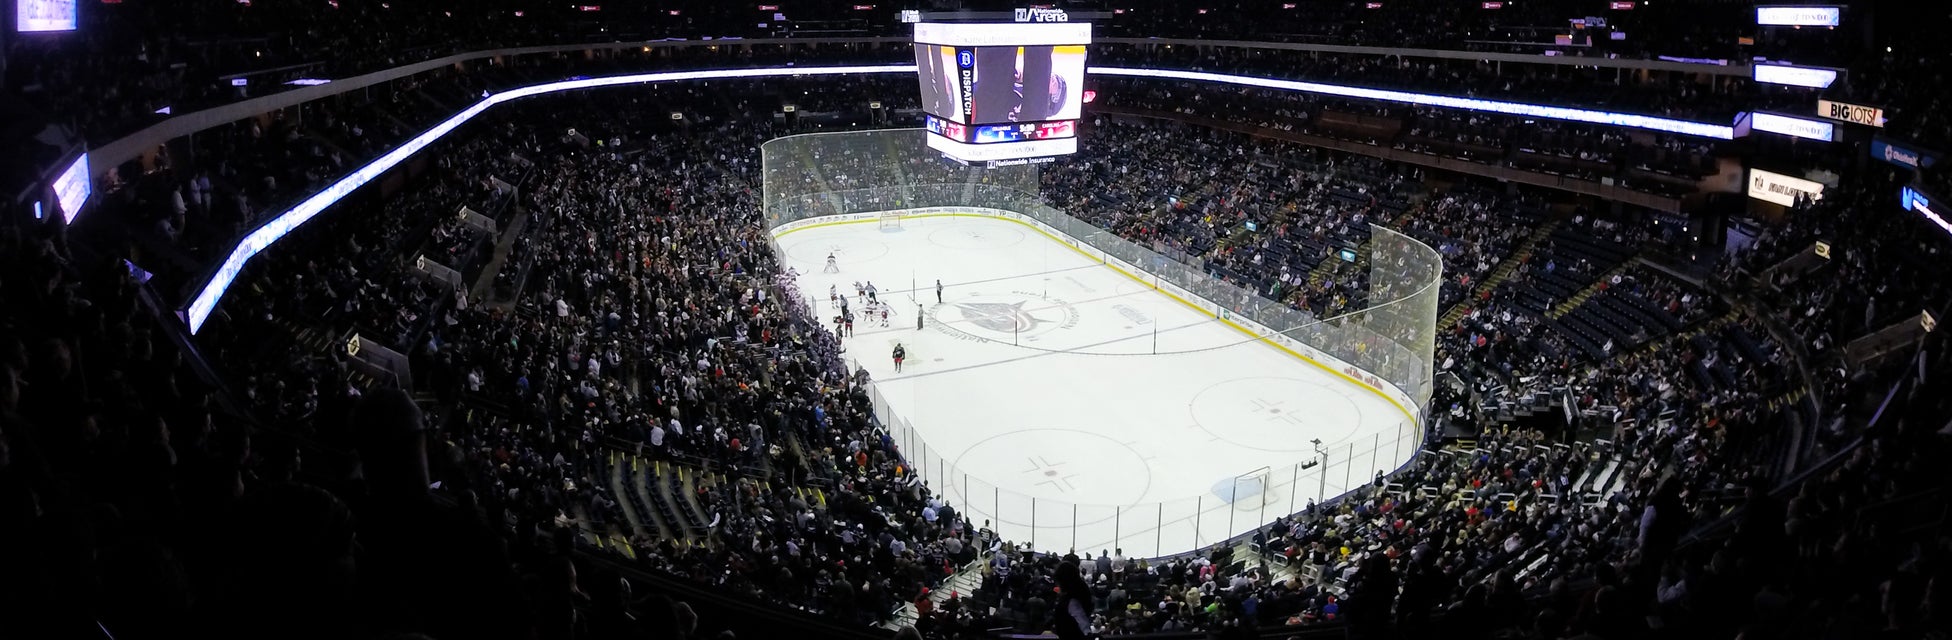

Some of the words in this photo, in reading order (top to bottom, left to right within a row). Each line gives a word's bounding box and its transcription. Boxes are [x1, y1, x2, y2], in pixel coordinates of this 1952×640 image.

[1026, 8, 1068, 22] Arena
[962, 70, 972, 115] DISPATCH
[1831, 103, 1850, 118] BIG
[995, 159, 1028, 167] Nationwide
